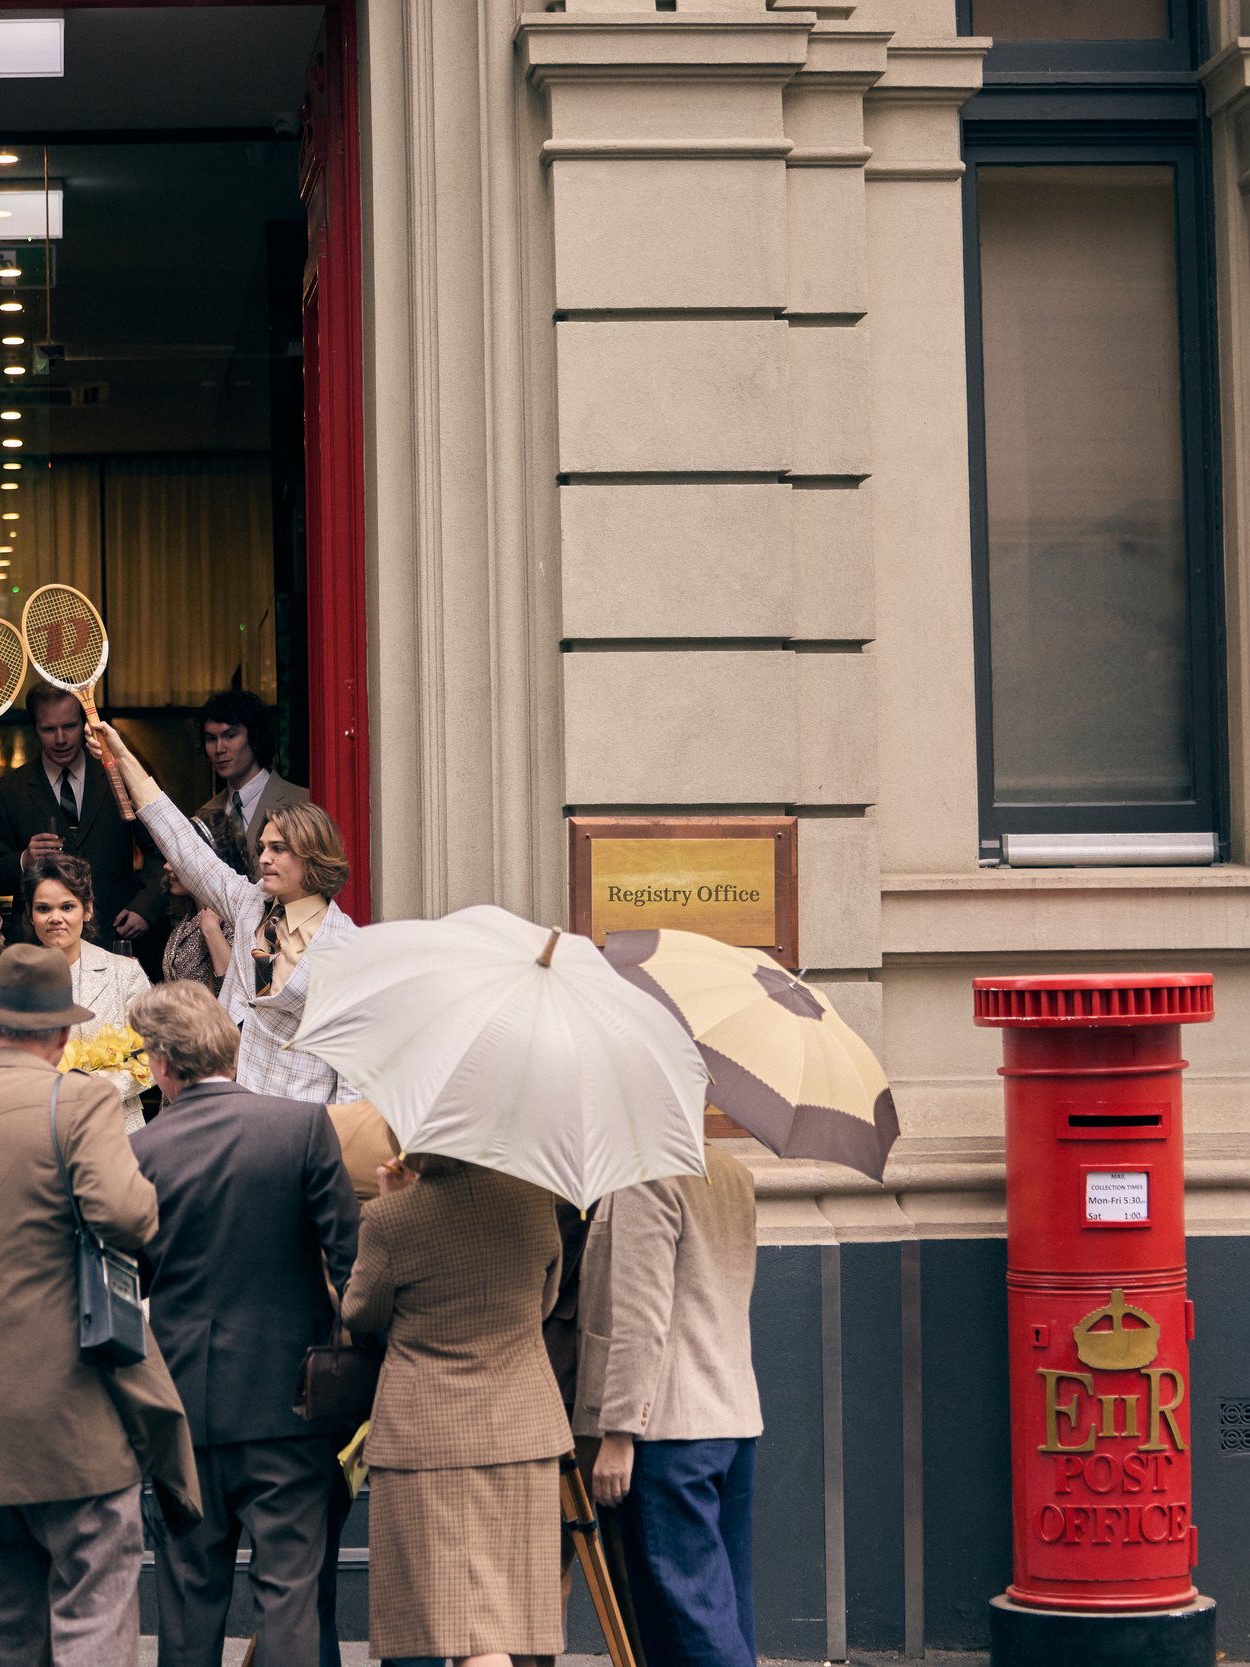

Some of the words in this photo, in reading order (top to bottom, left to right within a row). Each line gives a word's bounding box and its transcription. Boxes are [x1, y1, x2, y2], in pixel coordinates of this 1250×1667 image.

[608, 885, 692, 907] Registry
[697, 884, 760, 902] Office
[1088, 1212, 1102, 1221] Sat
[1053, 1453, 1174, 1495] POST
[1036, 1502, 1188, 1544] OFFICE
